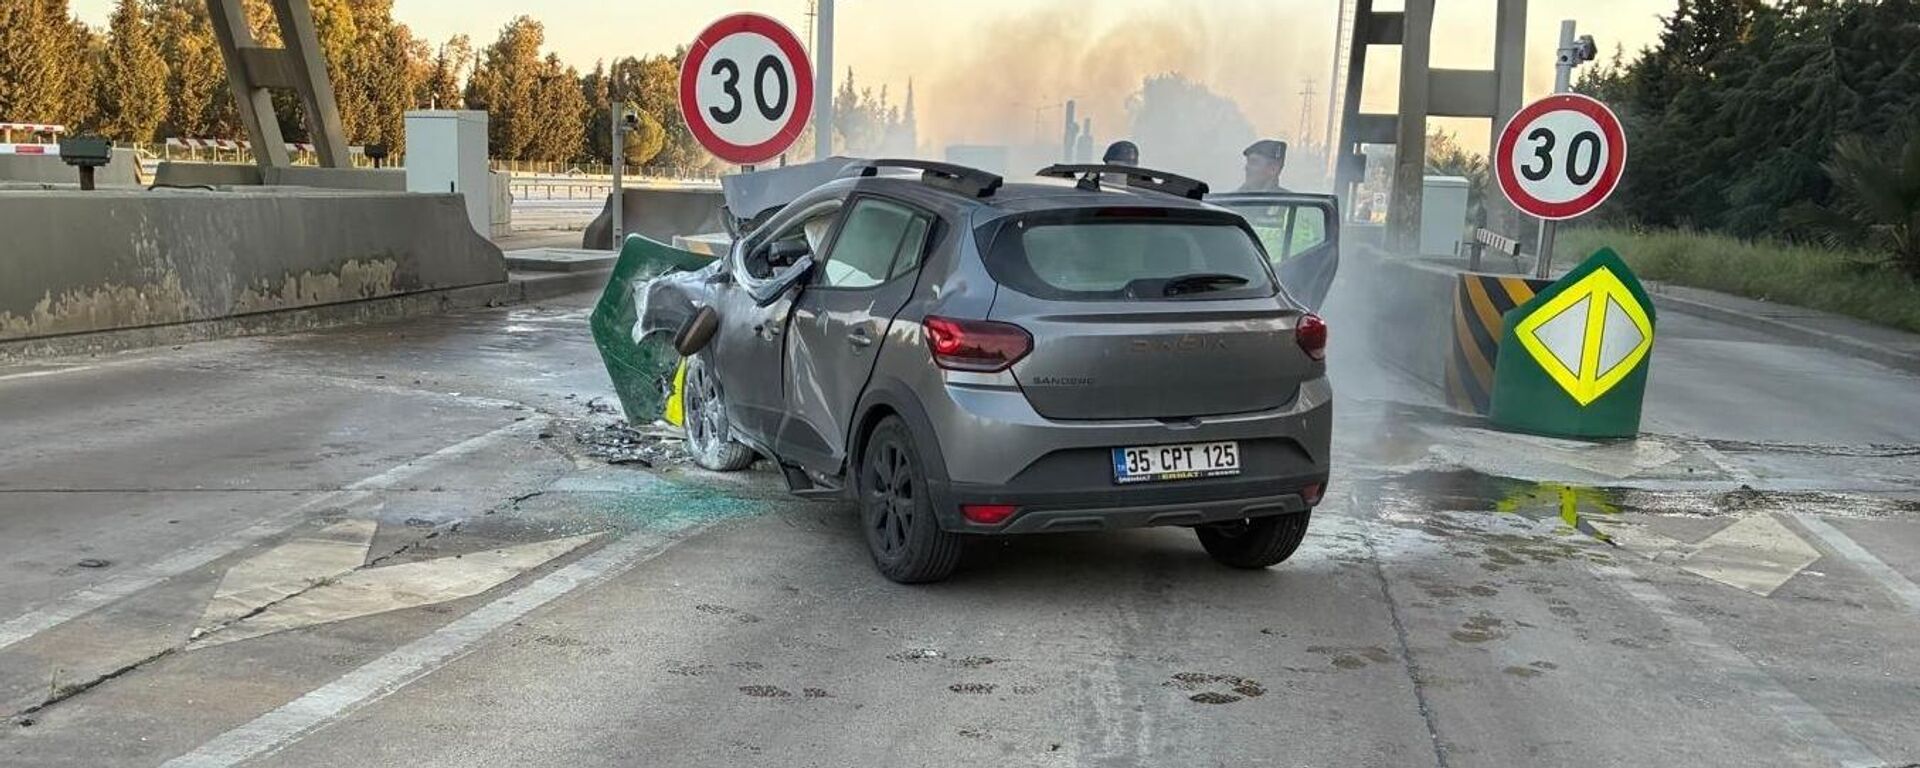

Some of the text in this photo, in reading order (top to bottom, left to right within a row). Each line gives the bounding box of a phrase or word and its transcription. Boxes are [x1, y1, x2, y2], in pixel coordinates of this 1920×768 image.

[709, 54, 789, 124] 30
[1521, 127, 1602, 186] 30
[1127, 444, 1235, 473] 35 CPT 125
